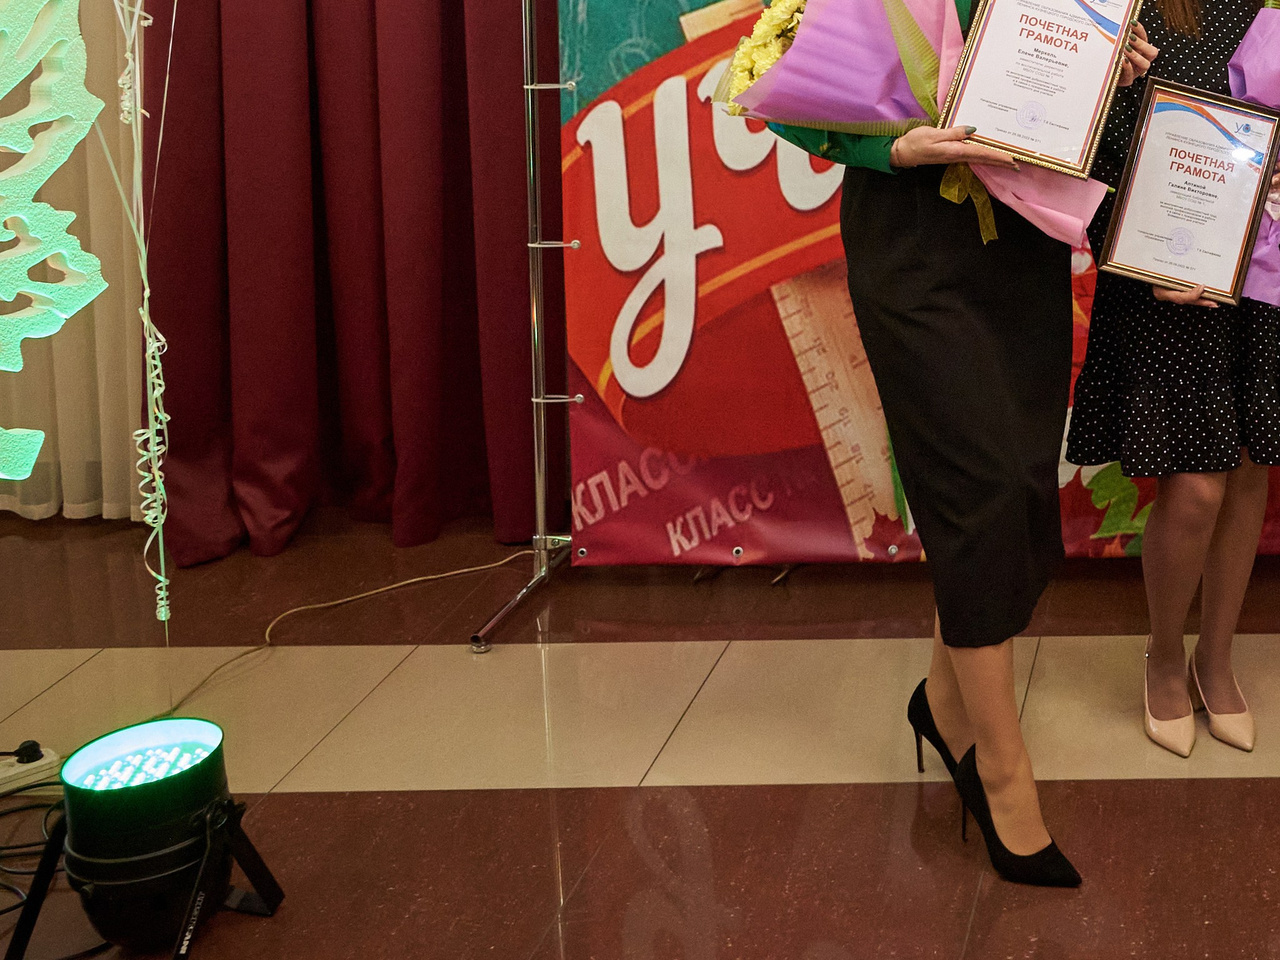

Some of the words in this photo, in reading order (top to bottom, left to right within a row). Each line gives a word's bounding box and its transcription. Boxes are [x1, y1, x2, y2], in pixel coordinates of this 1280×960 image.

[1019, 14, 1088, 42] ПОЧЕТНАЯ
[1019, 28, 1079, 53] ГРАМОТА
[1169, 148, 1235, 172] ПОЧЕТНАЯ
[1169, 161, 1227, 184] ГРАМОТА
